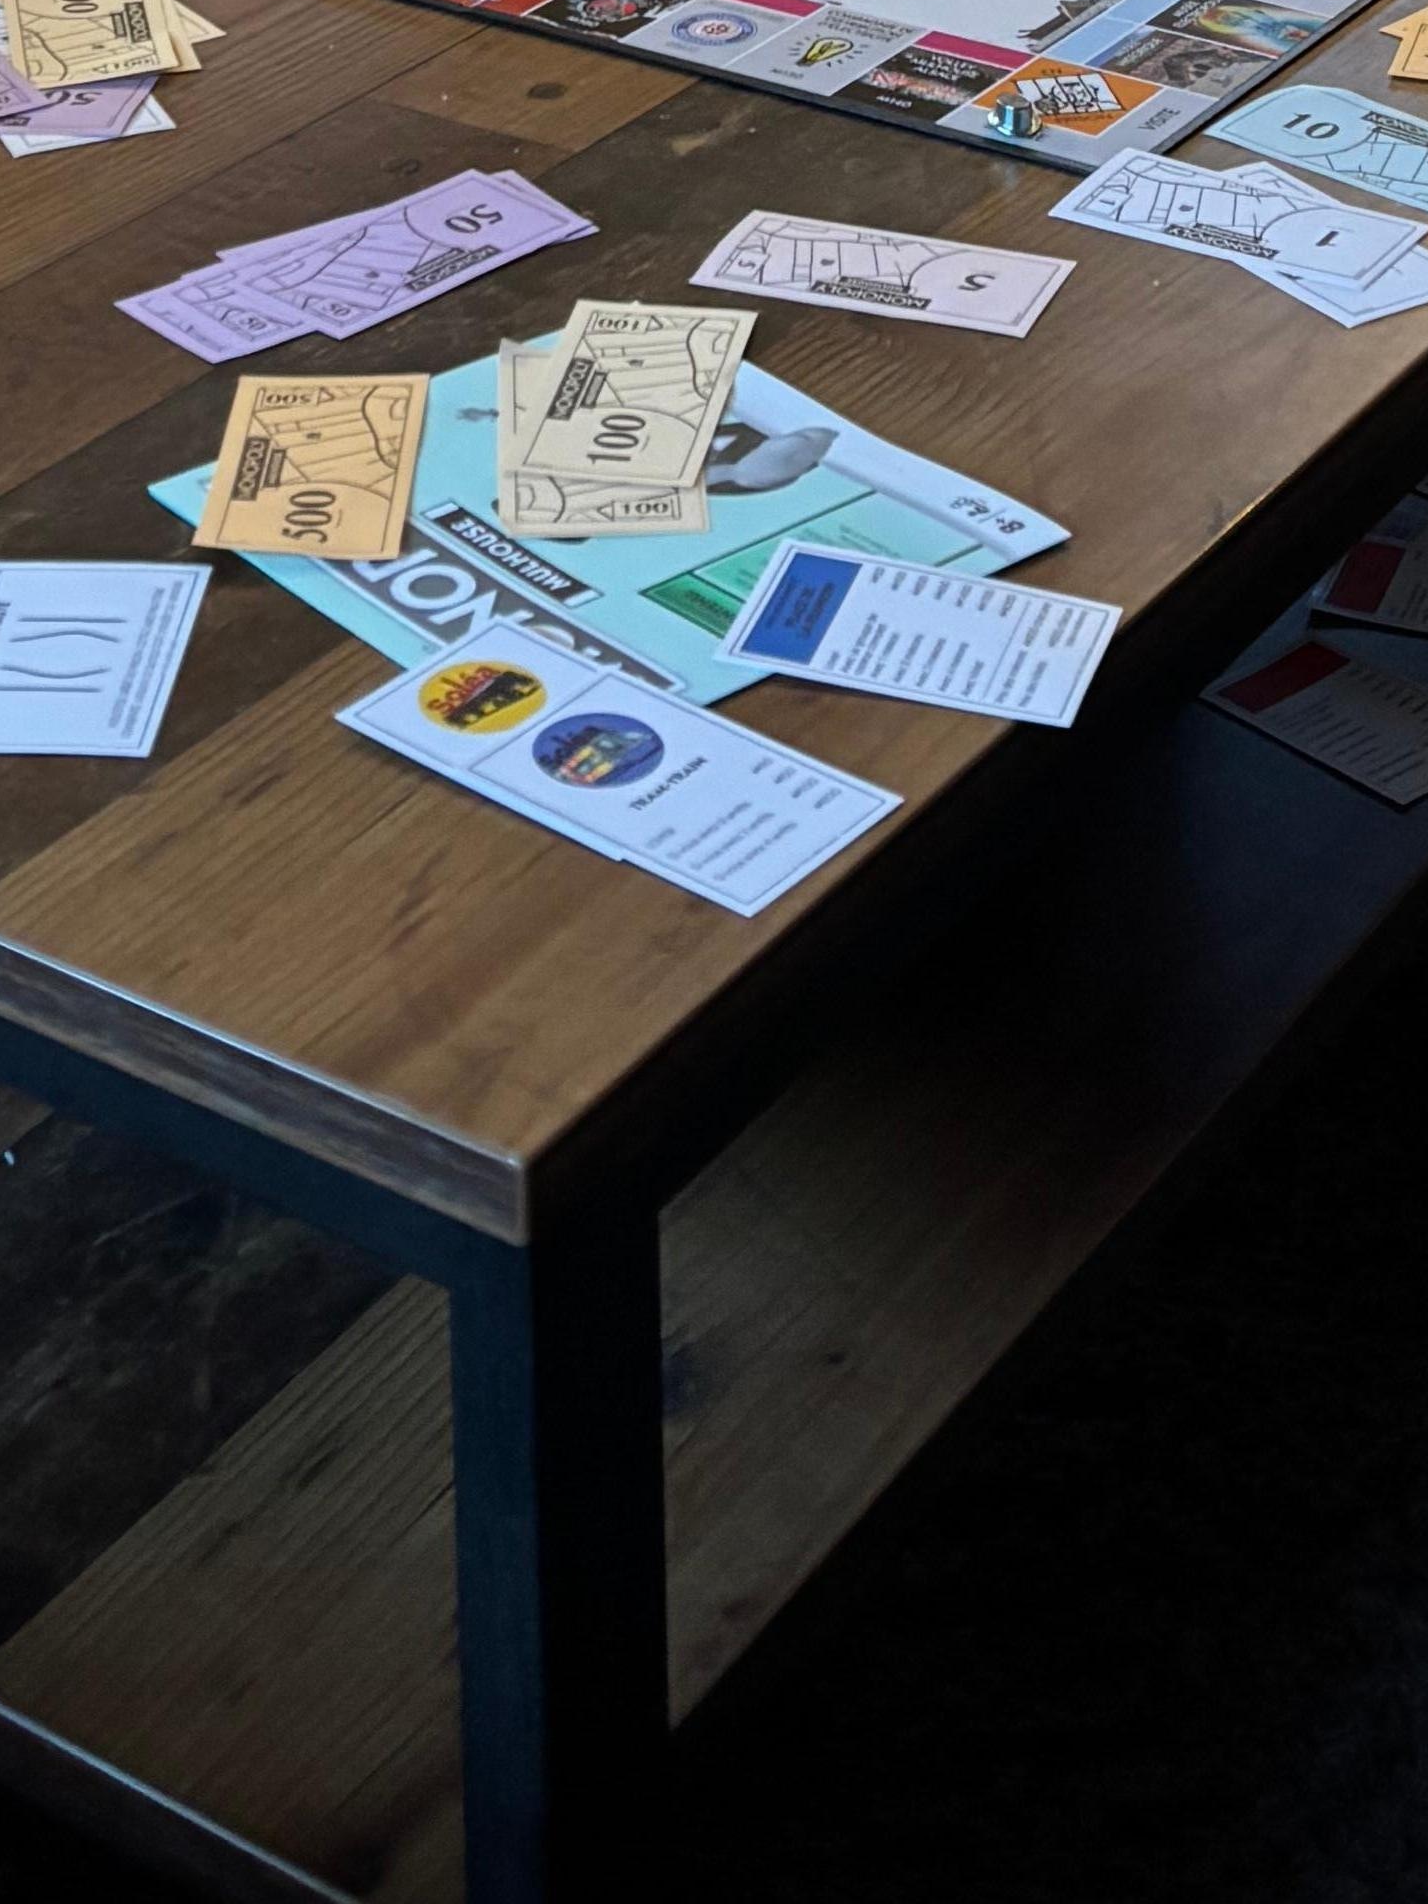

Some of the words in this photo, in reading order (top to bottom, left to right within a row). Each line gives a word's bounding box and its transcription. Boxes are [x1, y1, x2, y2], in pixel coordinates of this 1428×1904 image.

[1283, 112, 1340, 139] 10
[444, 202, 504, 235] 50
[1315, 230, 1340, 247] 1
[813, 283, 929, 309] MONOPOLY
[958, 273, 996, 293] 5
[598, 317, 640, 331] 100
[265, 392, 312, 406] 500
[585, 413, 646, 464] 100
[281, 490, 336, 544] 500
[623, 501, 668, 515] 100
[450, 516, 572, 592] MULHOUSE
